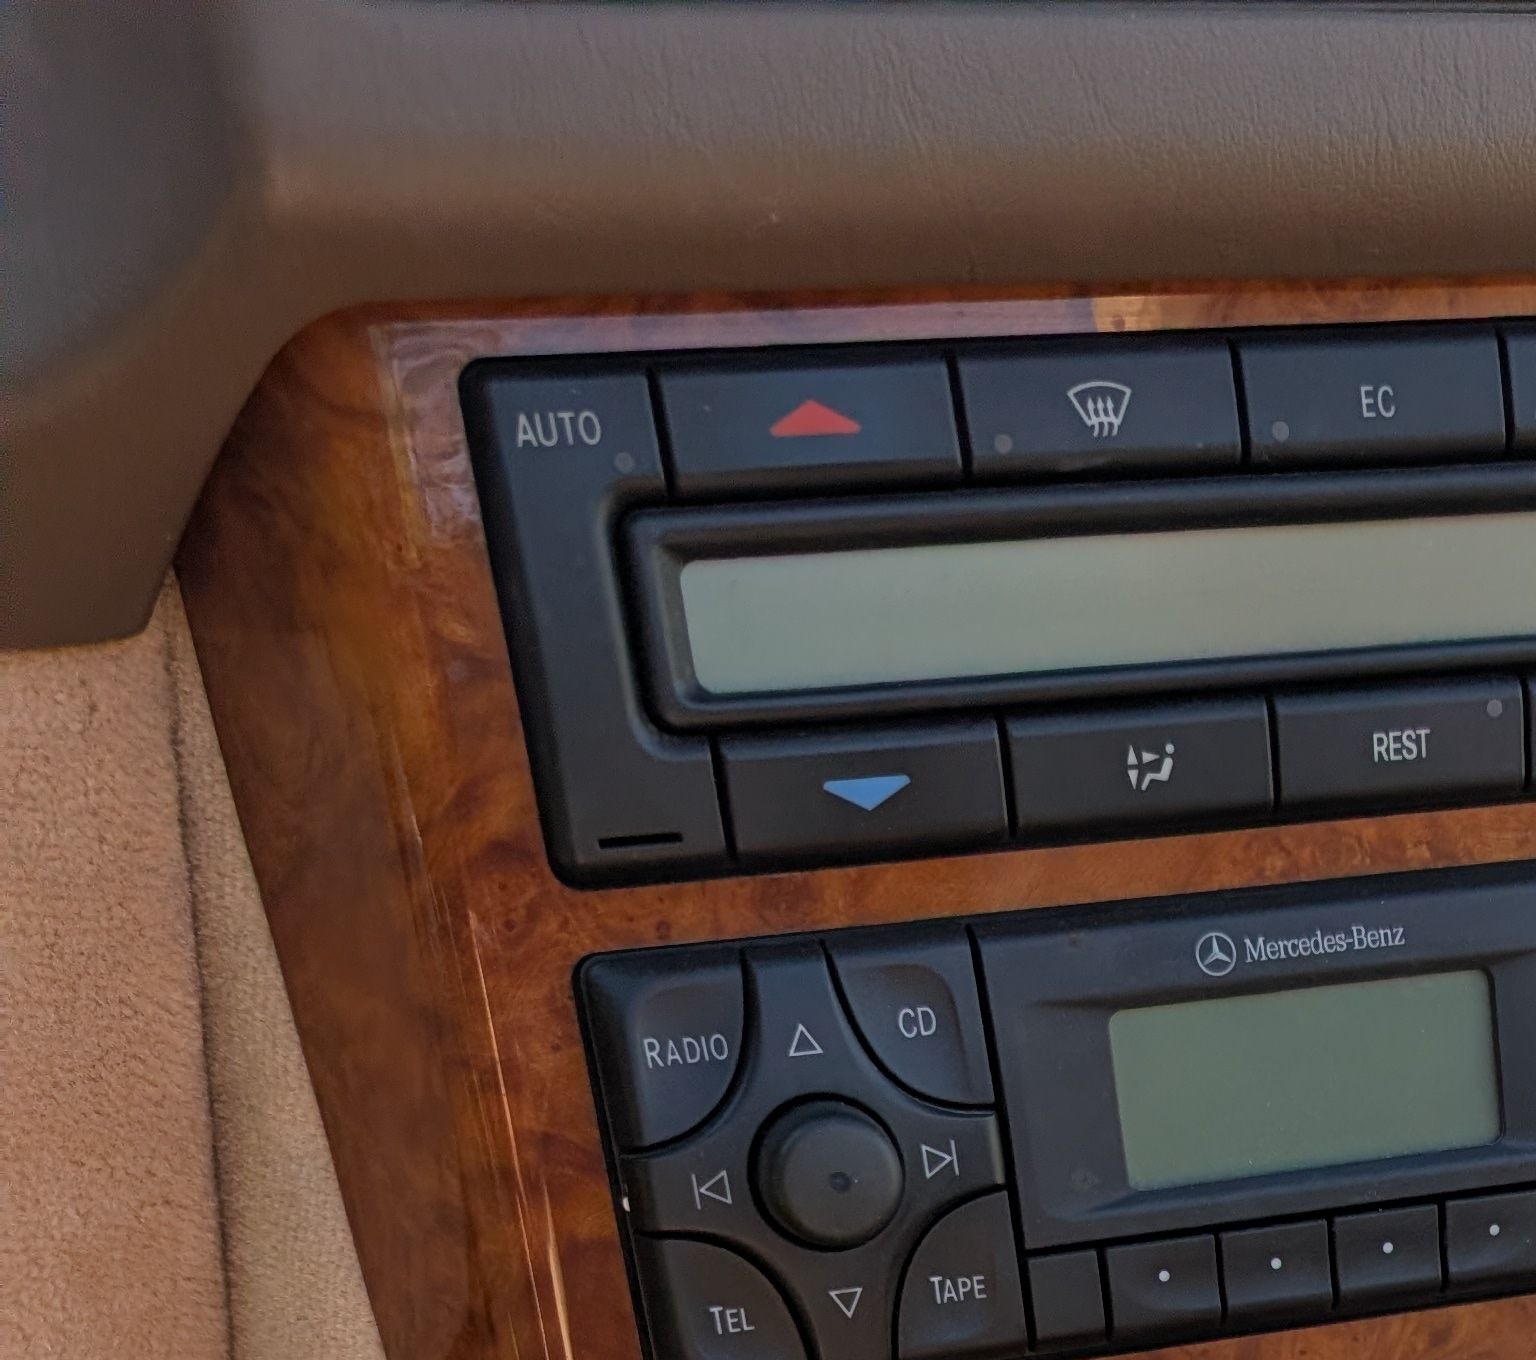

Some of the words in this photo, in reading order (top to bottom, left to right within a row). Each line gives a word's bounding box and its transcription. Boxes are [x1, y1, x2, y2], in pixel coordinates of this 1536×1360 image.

[1360, 385, 1396, 418] EC
[516, 411, 601, 449] AUTO
[1372, 729, 1430, 762] REST
[1244, 925, 1406, 965] Mercedes-Benz
[898, 1006, 937, 1039] CD
[643, 1033, 729, 1069] RADIO
[929, 1275, 987, 1306] TAPE
[709, 1306, 755, 1336] TEL
